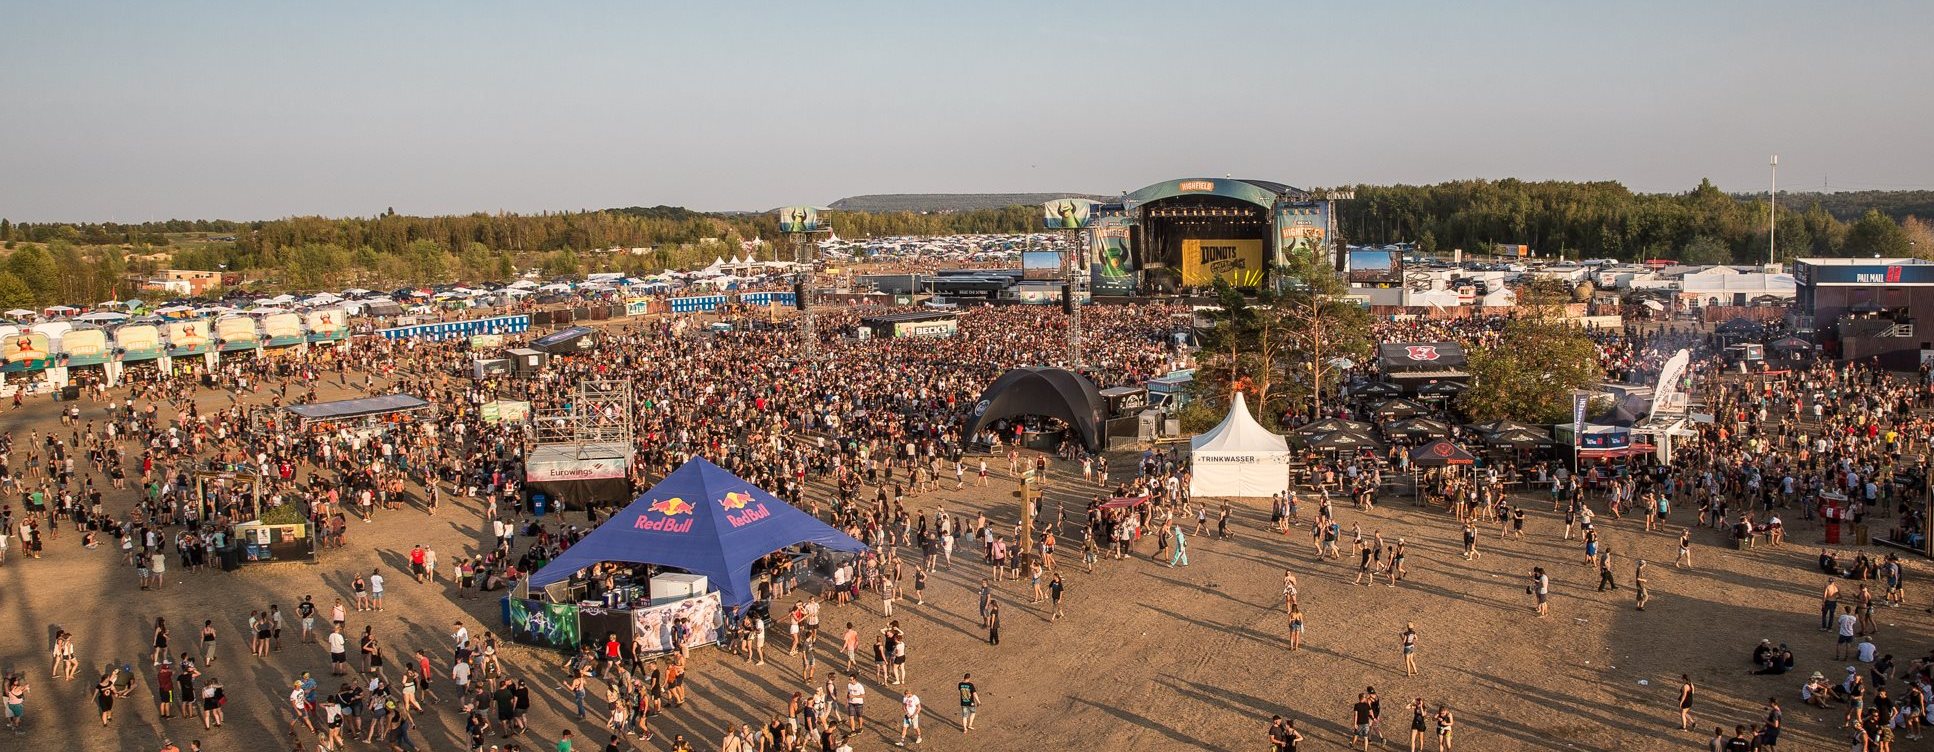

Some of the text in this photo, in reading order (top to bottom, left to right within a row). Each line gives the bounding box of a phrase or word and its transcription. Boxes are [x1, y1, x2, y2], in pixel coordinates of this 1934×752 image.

[1182, 181, 1214, 192] HIGHFIELD
[1100, 228, 1129, 238] GHFIELD
[1283, 227, 1323, 237] HIGHFI
[1201, 246, 1236, 264] DONOTS
[1857, 274, 1884, 282] PALL MALL
[916, 325, 947, 335] BECK'S
[550, 468, 593, 477] Eurowings
[726, 503, 770, 528] Red Bull
[634, 515, 694, 533] Red Bull
